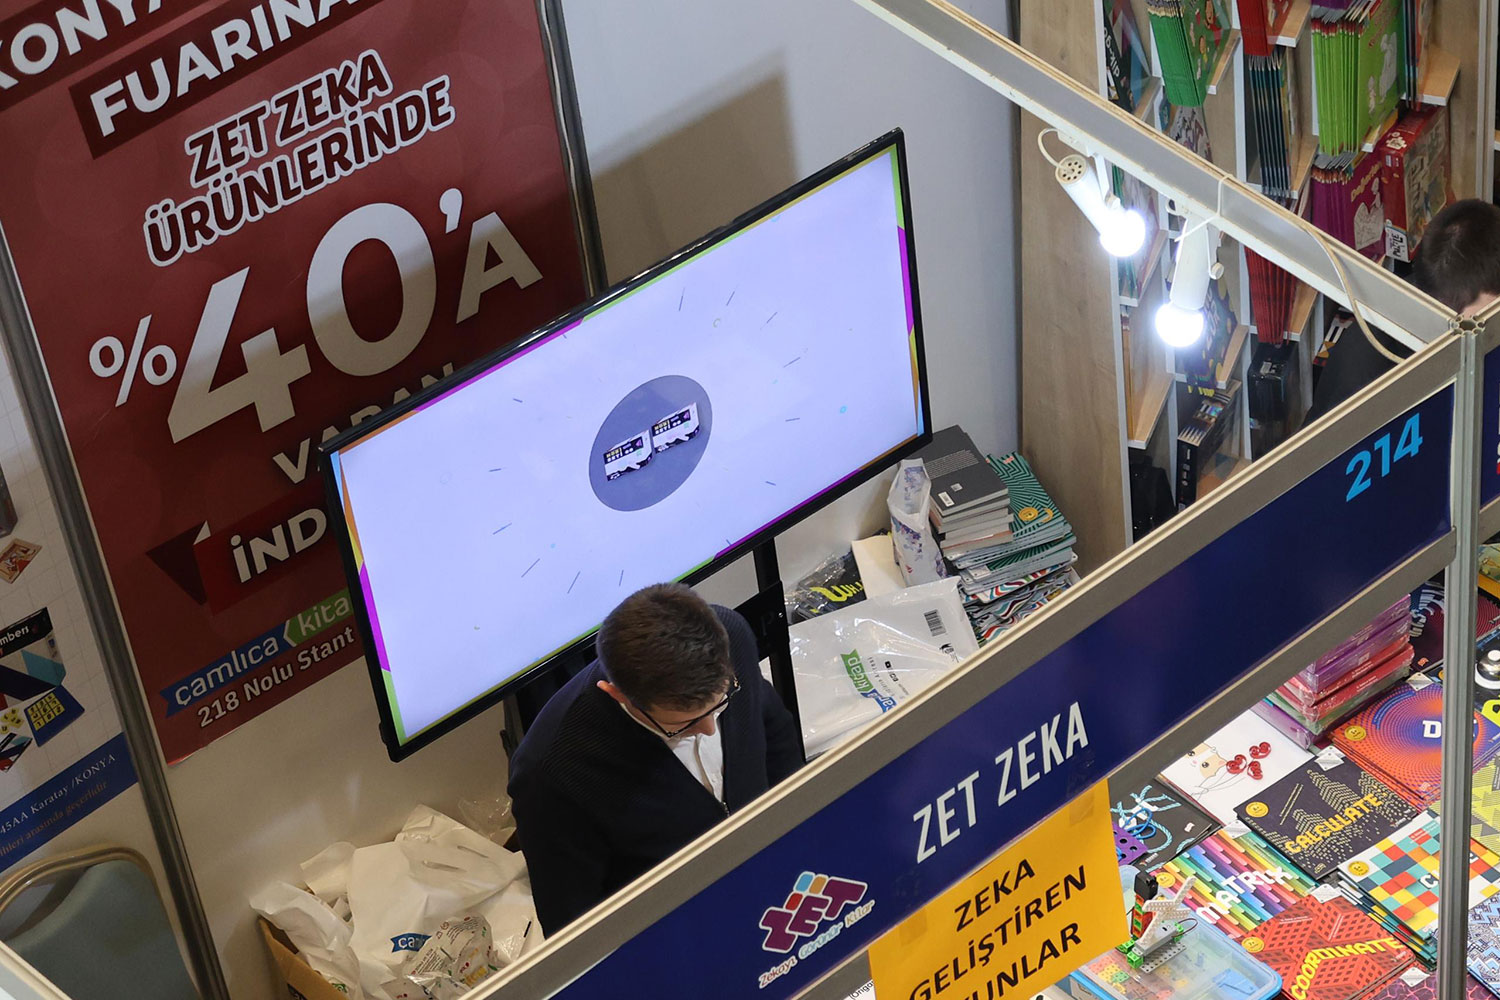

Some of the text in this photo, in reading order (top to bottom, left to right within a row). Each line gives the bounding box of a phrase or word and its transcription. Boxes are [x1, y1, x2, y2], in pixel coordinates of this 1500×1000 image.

[0, 0, 161, 90] ONY
[184, 48, 393, 189] ZET ZEKA
[144, 74, 456, 267] ÜRÜNLERİNDE
[1345, 412, 1423, 502] 214
[196, 626, 356, 728] 218 Nolu Stant
[30, 784, 70, 814] Karatay
[913, 700, 1090, 865] ZET ZEKA
[1284, 791, 1384, 854] CALCULATE
[759, 871, 868, 954] ZET
[954, 857, 1036, 933] ZEKA
[1195, 865, 1294, 925] MATRIX
[1290, 935, 1406, 1000] COORDINATE
